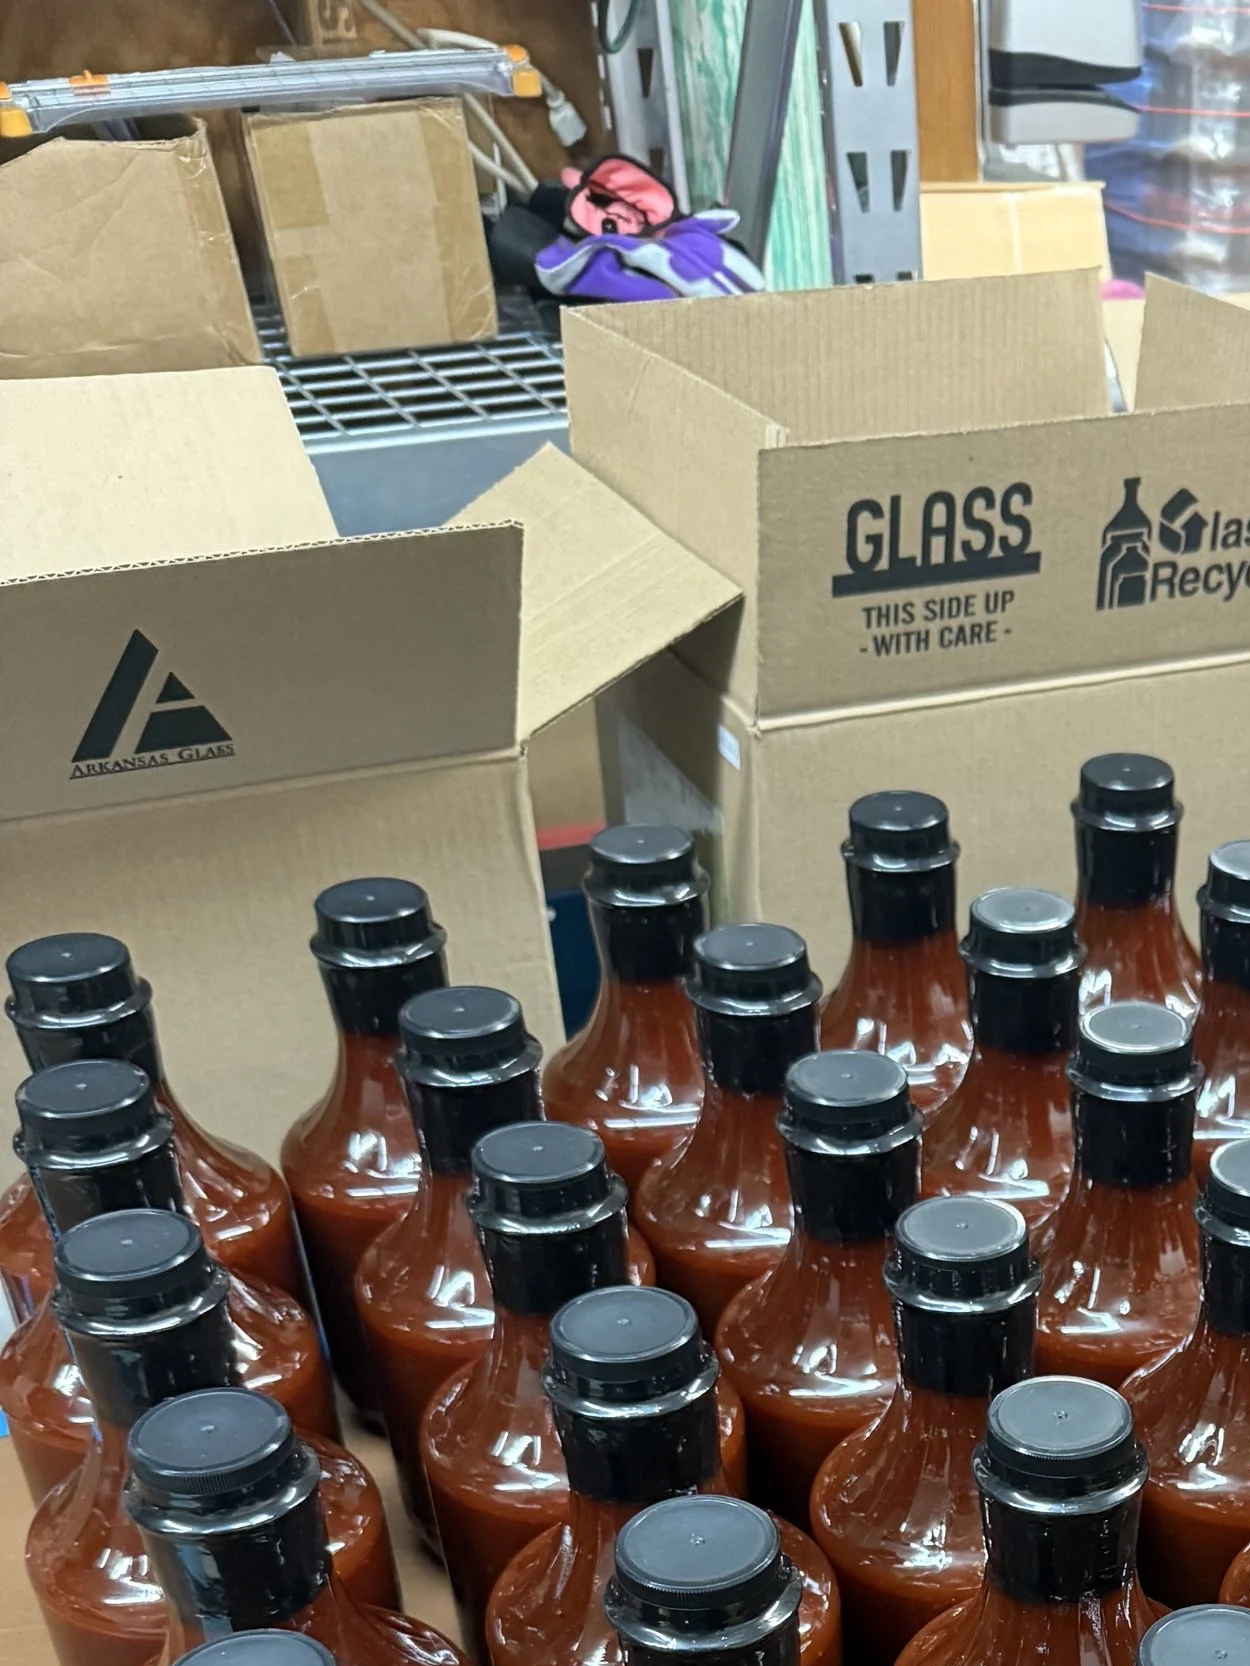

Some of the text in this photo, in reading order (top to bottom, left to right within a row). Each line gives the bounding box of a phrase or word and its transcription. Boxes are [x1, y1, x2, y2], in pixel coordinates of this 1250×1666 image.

[846, 482, 1033, 575] GLASS
[862, 590, 1016, 629] THIS SIDE UP
[70, 743, 235, 778] ARKANSAS GLASS
